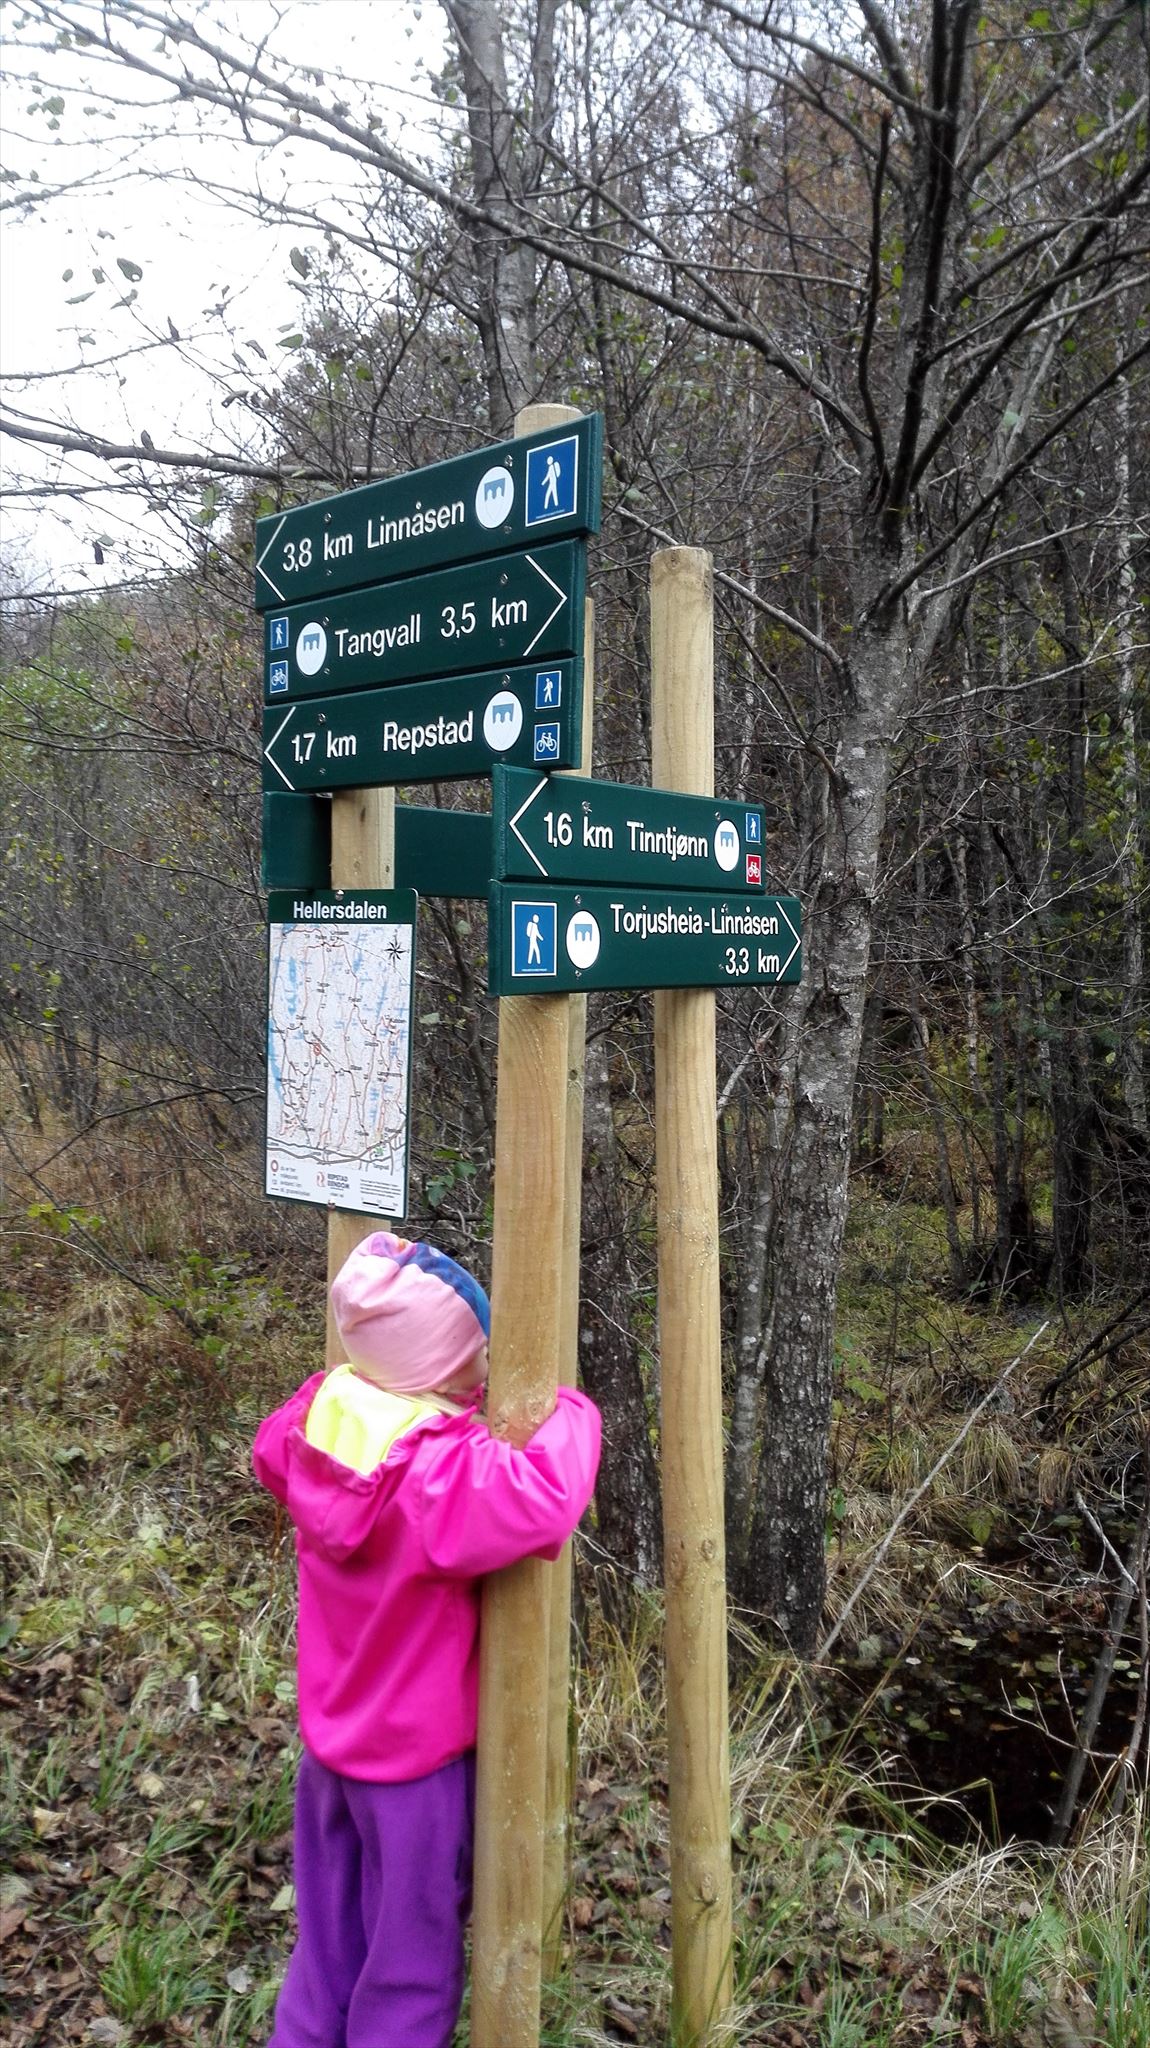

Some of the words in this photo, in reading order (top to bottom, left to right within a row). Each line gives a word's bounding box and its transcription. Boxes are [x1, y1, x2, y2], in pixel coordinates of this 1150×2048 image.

[282, 537, 313, 572] 3,8
[323, 532, 353, 561] km
[367, 501, 465, 549] Linnåsen
[334, 613, 421, 657] Tangvall
[440, 601, 476, 639] 3,5
[491, 597, 528, 628] km
[291, 732, 316, 765] 1,7
[326, 730, 357, 758] km
[383, 710, 474, 755] Repstad
[543, 811, 573, 848] 1,6
[583, 815, 614, 849] km
[626, 820, 708, 862] Tinntjønn
[293, 900, 387, 920] Hellersdalen
[609, 902, 779, 940] Torjusheia-Linnåsen
[725, 947, 750, 977] 3,3
[757, 948, 780, 974] km
